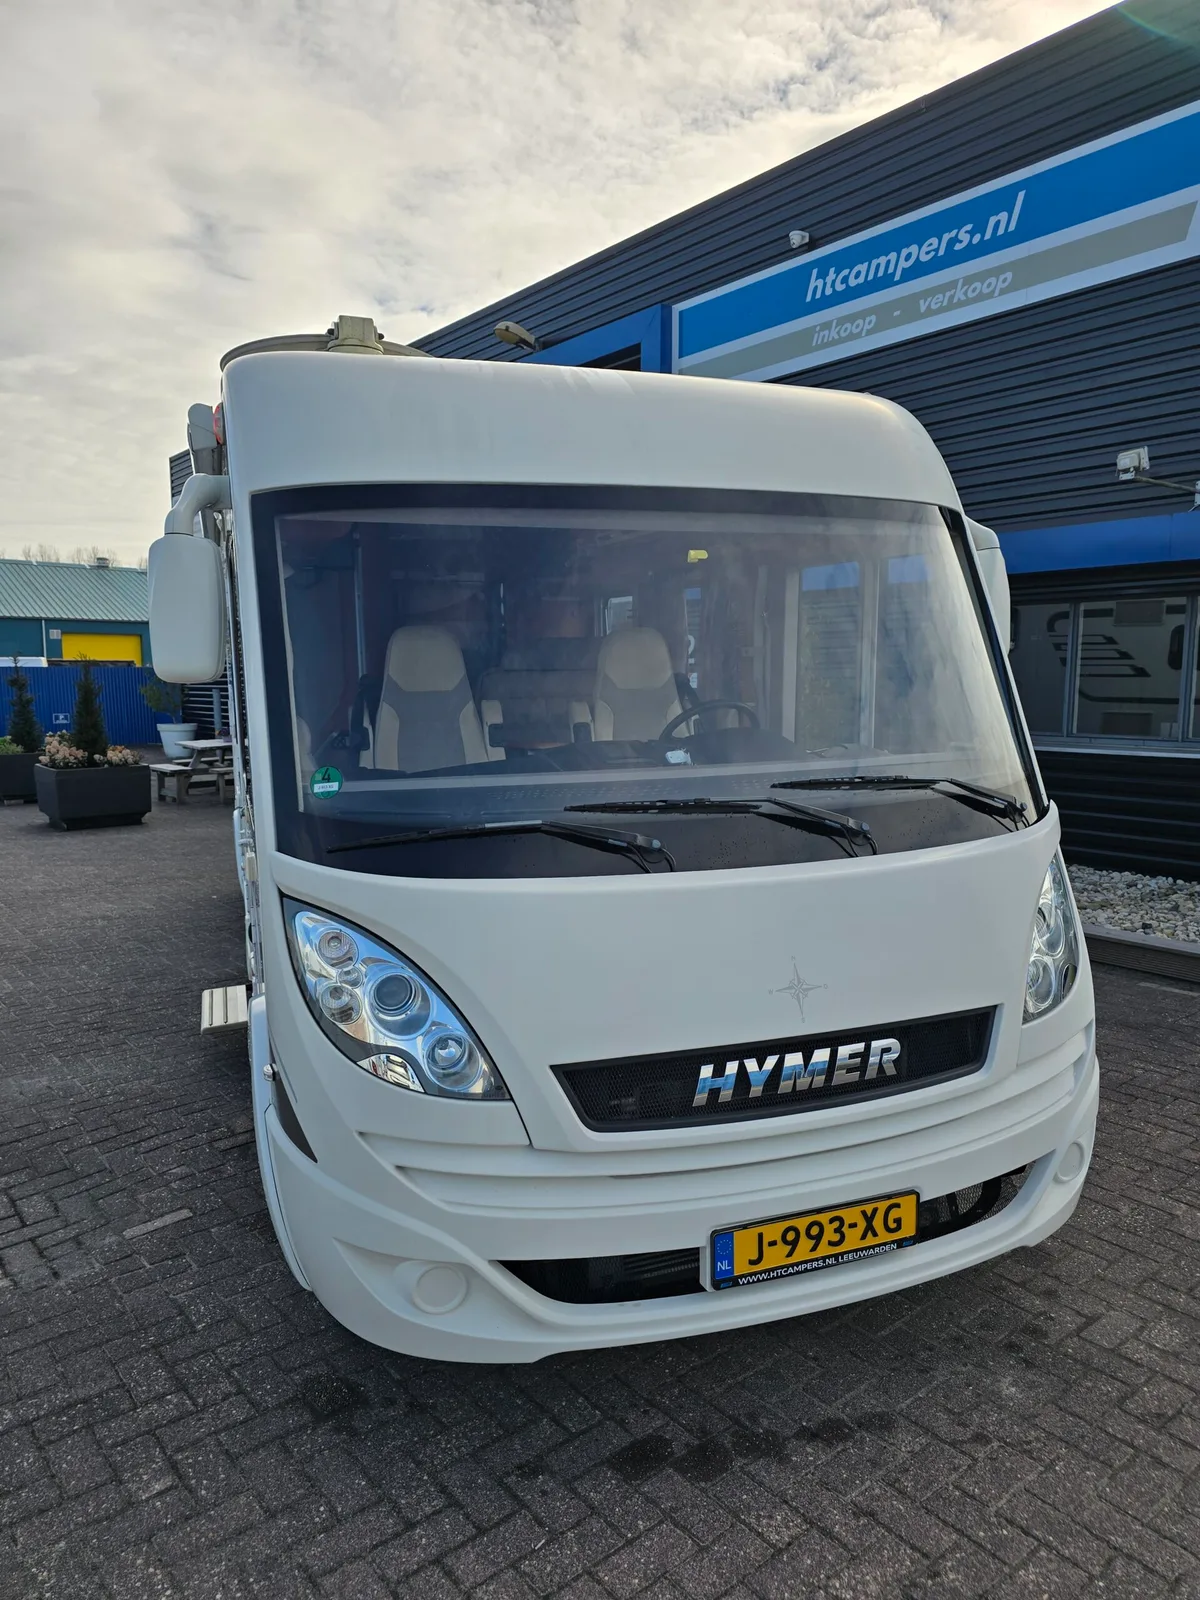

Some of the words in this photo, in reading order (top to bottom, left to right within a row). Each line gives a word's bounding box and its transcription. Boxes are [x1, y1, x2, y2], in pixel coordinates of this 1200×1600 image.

[805, 190, 1026, 303] htcampers.nl
[812, 314, 877, 347] inkoop
[919, 271, 1013, 314] verkoop
[692, 1037, 901, 1107] HYMER
[717, 1260, 732, 1272] NL
[738, 1256, 837, 1285] WWW.HTCAMPERS.NL
[838, 1242, 897, 1263] LEEUWARDEN
[748, 1202, 902, 1266] J-993-XG
